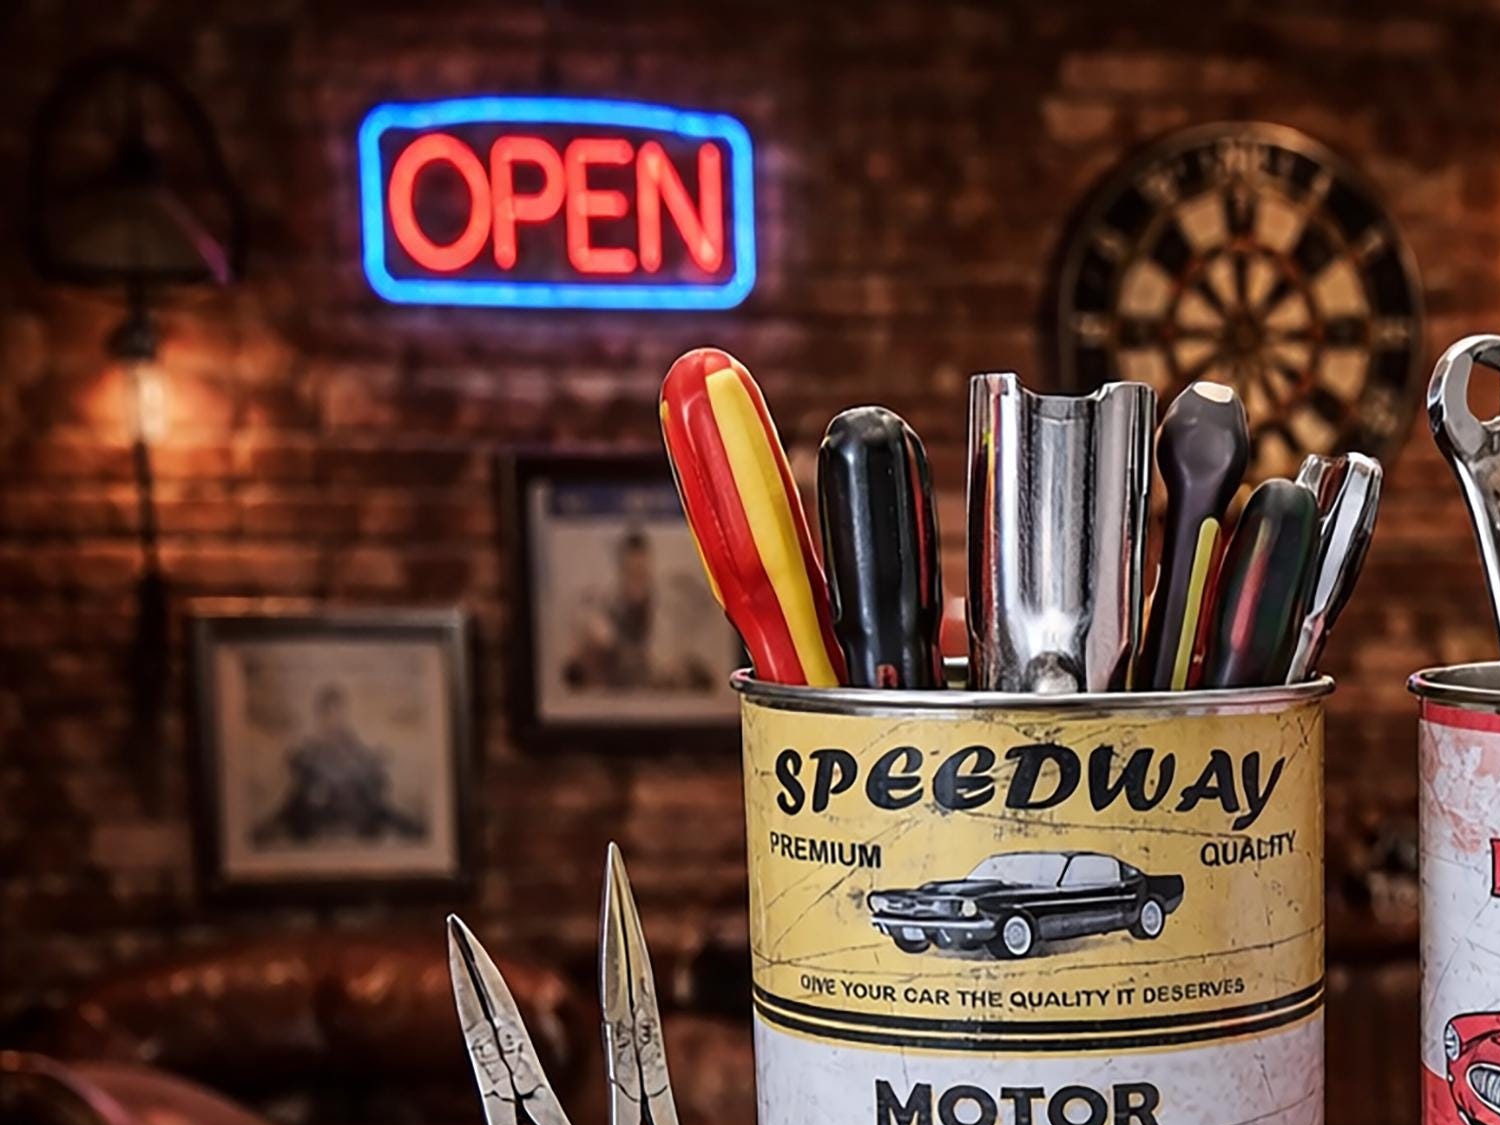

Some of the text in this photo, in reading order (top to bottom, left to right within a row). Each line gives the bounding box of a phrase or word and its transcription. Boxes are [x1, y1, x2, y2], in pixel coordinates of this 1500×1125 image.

[388, 133, 724, 275] OPEN
[775, 743, 1285, 830] SPEEDWAY
[770, 831, 881, 868] PREMIUM
[1200, 829, 1296, 867] QUALITY
[840, 980, 897, 1002] YOUR
[903, 987, 950, 1006] CAR
[956, 990, 1003, 1009] THE
[1009, 989, 1110, 1009] QUALITY
[1117, 988, 1136, 1005] IT
[1143, 977, 1245, 1003] DESERVES
